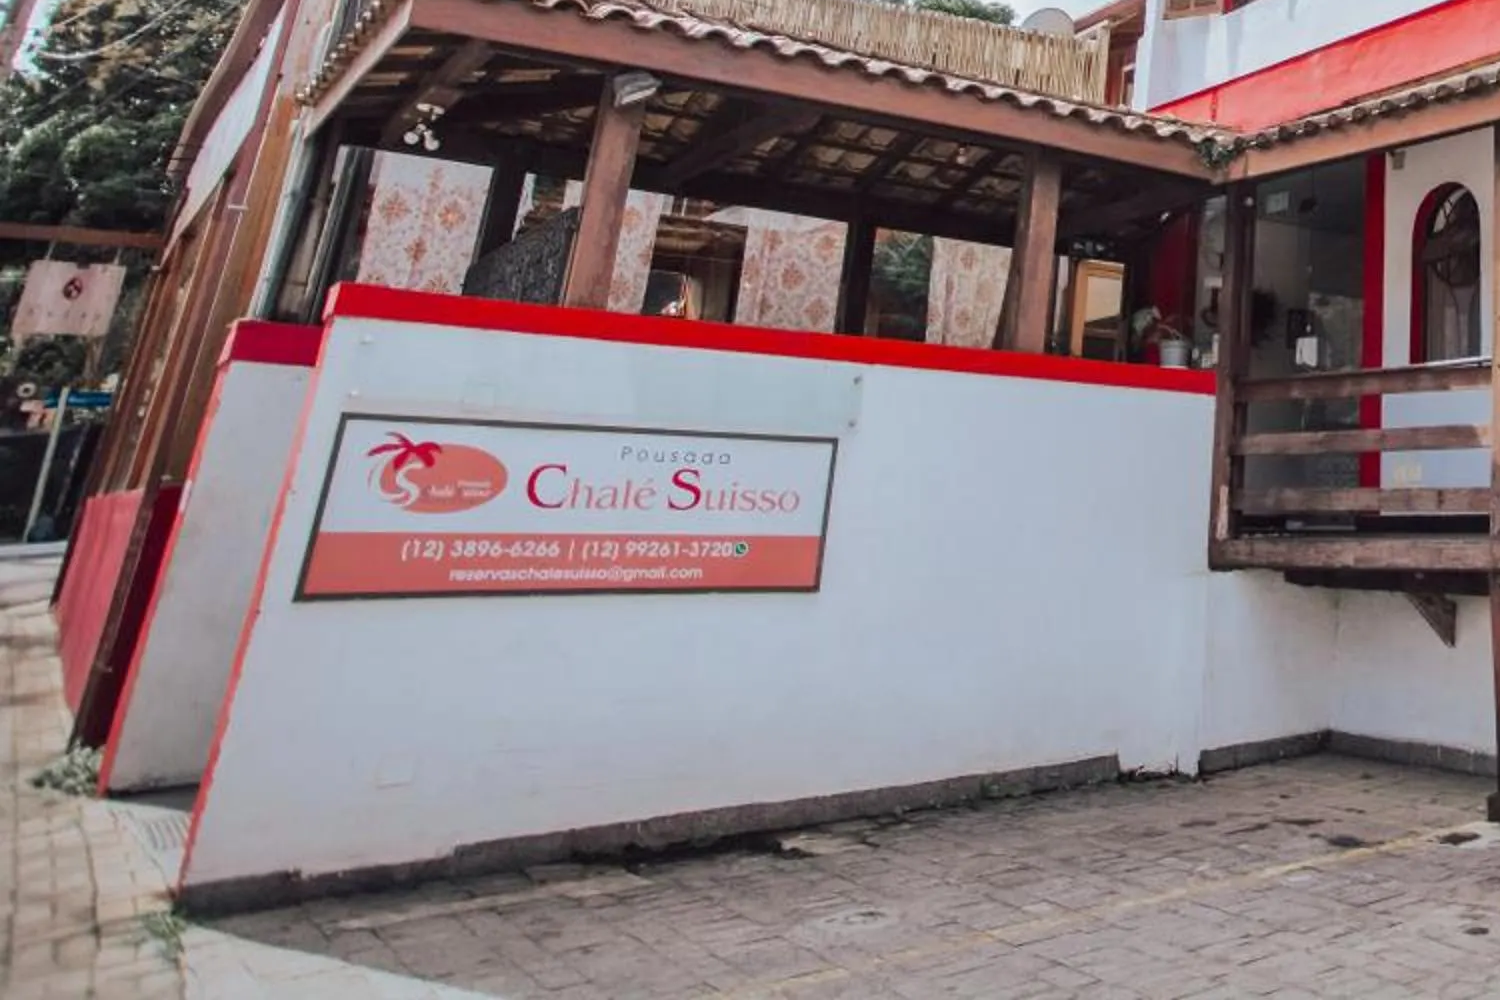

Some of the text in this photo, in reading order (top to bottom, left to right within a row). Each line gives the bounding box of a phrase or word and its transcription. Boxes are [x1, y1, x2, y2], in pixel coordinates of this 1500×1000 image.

[620, 445, 733, 465] Pousada
[526, 463, 800, 513] Chalé Suisso
[401, 539, 445, 561] (12)
[450, 539, 561, 558] 3896-6266
[581, 540, 620, 561] (12)
[625, 540, 733, 558] 99261-3720
[448, 566, 704, 581] reservaschalesuisso@gmail.com
